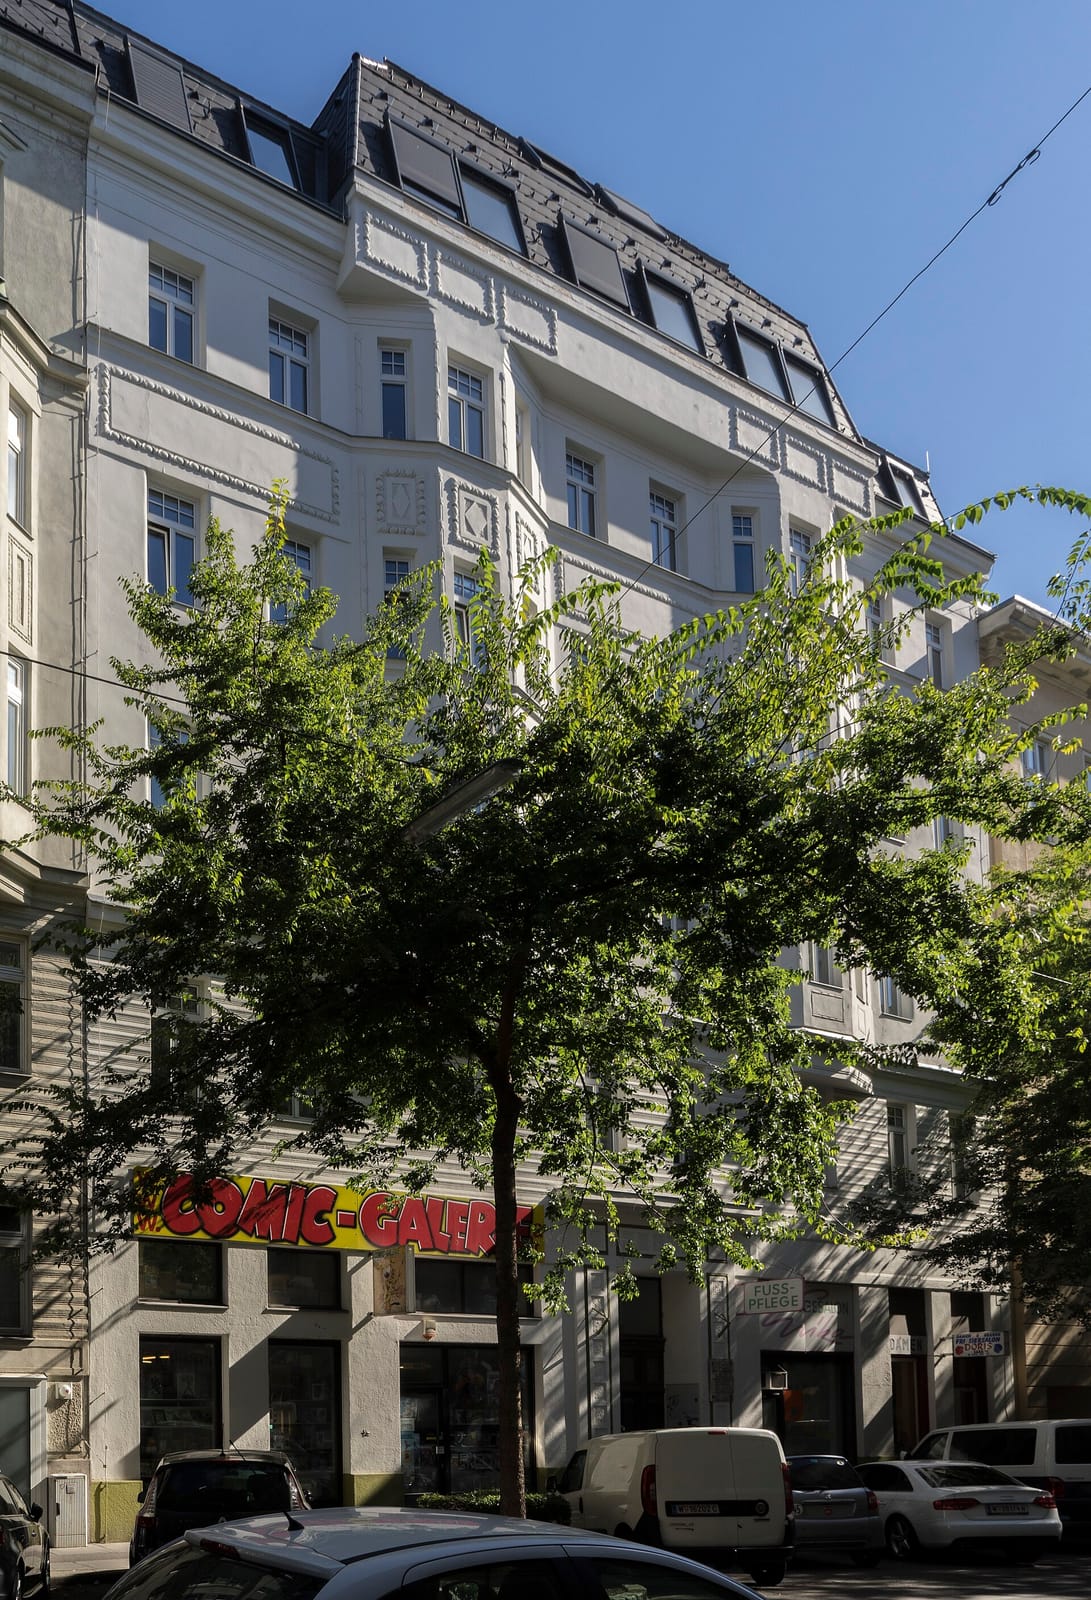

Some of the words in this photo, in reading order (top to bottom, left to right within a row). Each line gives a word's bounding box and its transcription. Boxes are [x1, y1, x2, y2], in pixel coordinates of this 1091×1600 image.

[161, 1171, 534, 1257] COMIC-GALERE
[753, 1282, 795, 1297] FUSS-
[748, 1295, 799, 1310] PFLEGE
[889, 1336, 923, 1351] DAMEN
[964, 1342, 993, 1351] DORIS
